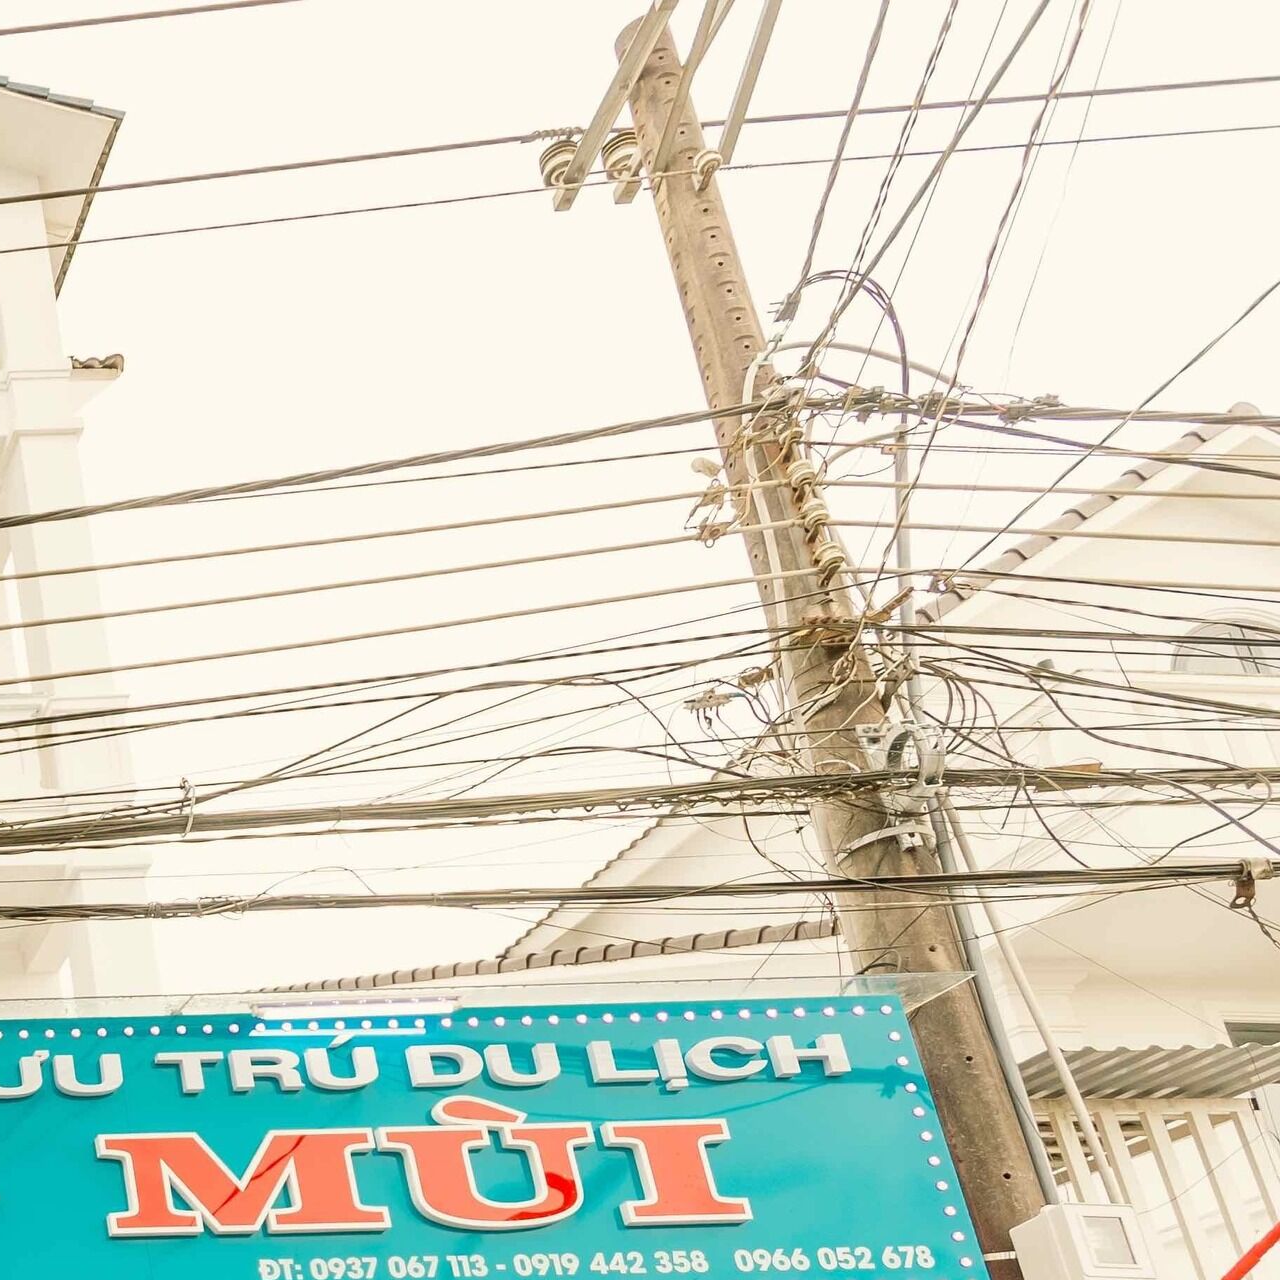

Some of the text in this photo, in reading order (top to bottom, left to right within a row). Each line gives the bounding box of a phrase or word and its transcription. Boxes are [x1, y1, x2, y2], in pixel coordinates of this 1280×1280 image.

[155, 1034, 379, 1094] TRÚ
[405, 1041, 561, 1088] DU
[586, 1033, 852, 1091] LỊCH
[94, 1095, 753, 1238] MÙI
[258, 1258, 304, 1280] ĐT:
[310, 1257, 378, 1280] 0937
[388, 1256, 439, 1279] 067
[446, 1255, 488, 1278] 113
[513, 1253, 580, 1276] 0919
[590, 1252, 646, 1275] 442
[654, 1250, 709, 1274] 358
[734, 1248, 811, 1272] 0966
[817, 1247, 875, 1271] 052
[881, 1245, 935, 1269] 678
